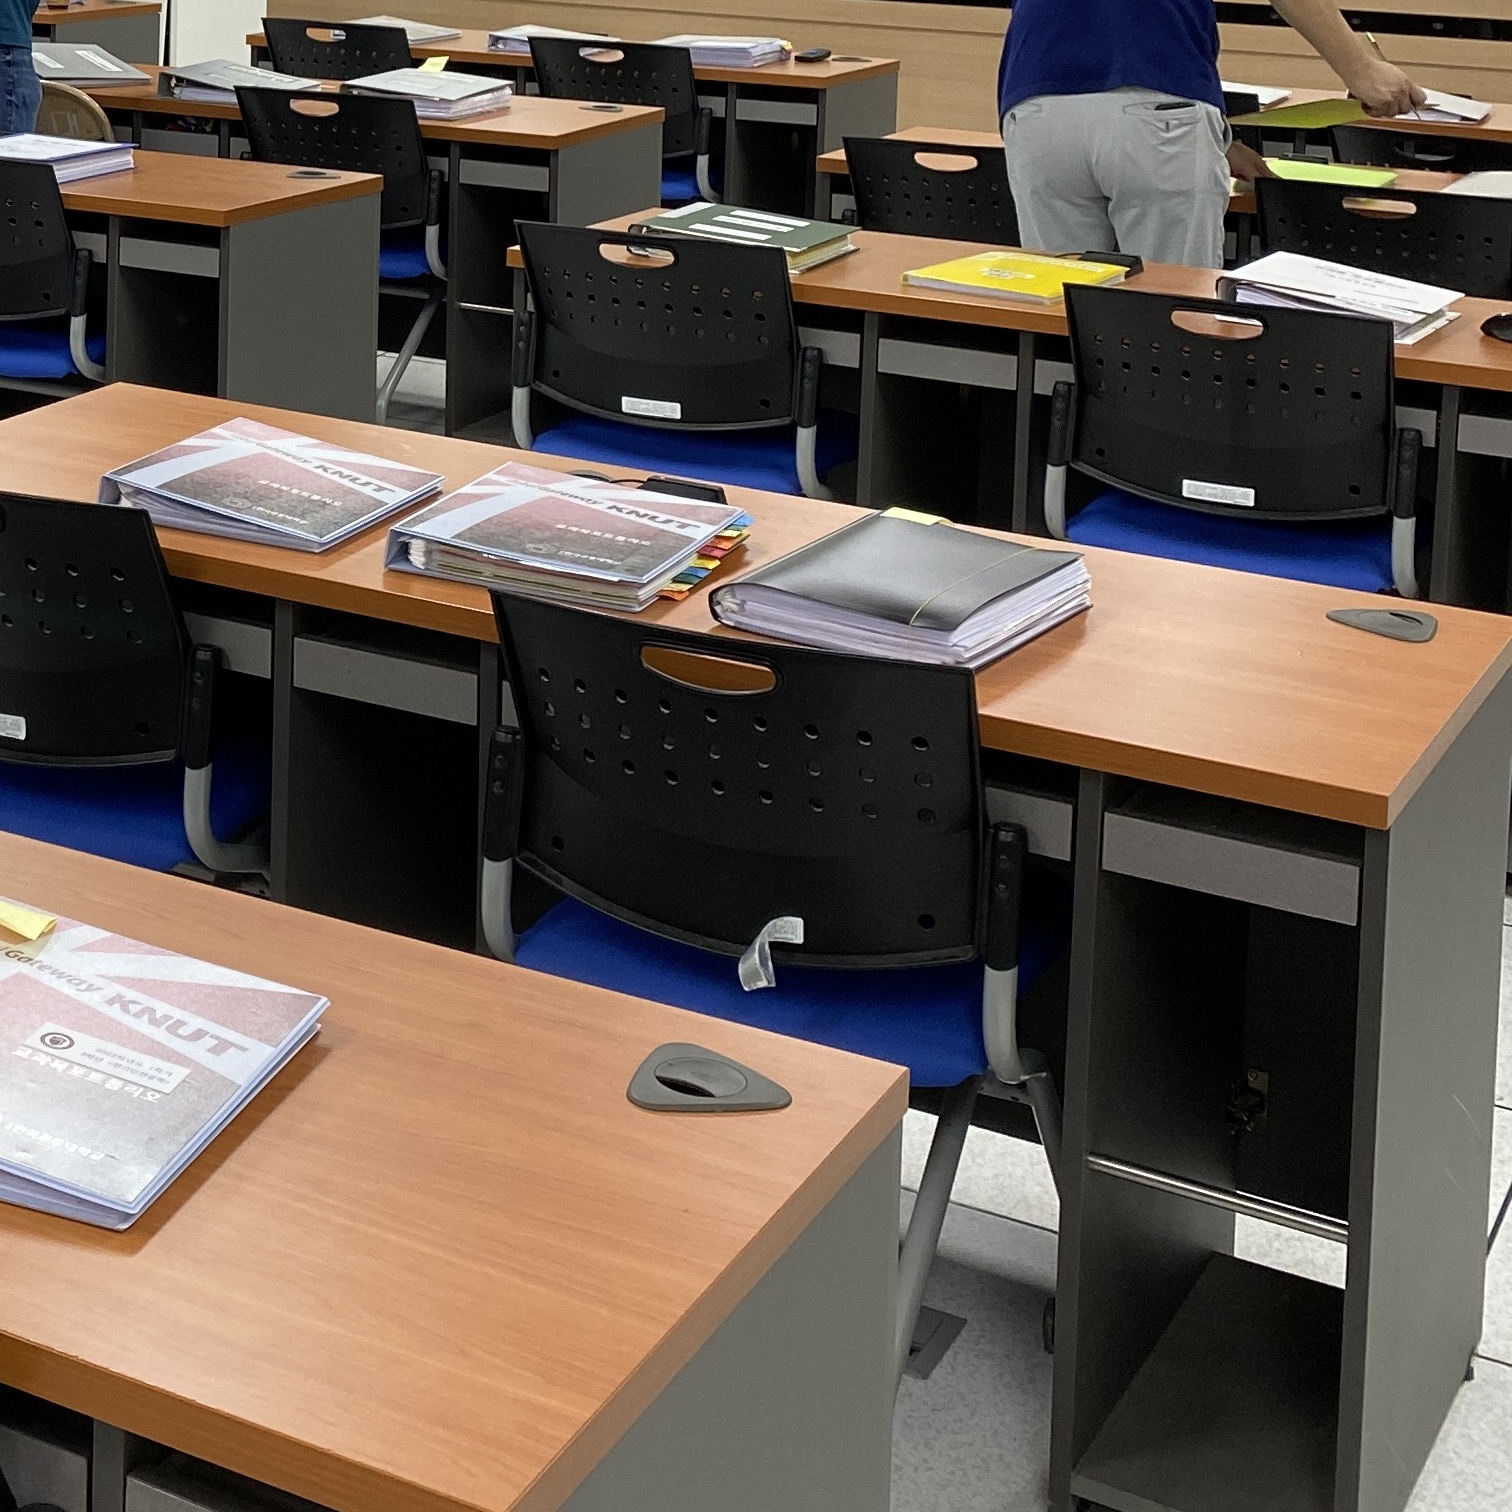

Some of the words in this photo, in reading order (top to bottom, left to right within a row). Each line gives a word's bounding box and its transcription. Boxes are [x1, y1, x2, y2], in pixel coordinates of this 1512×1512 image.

[313, 464, 396, 494] KNUT
[606, 504, 702, 530] KNUT
[4, 949, 105, 993] Gateway
[103, 992, 249, 1057] KNUT
